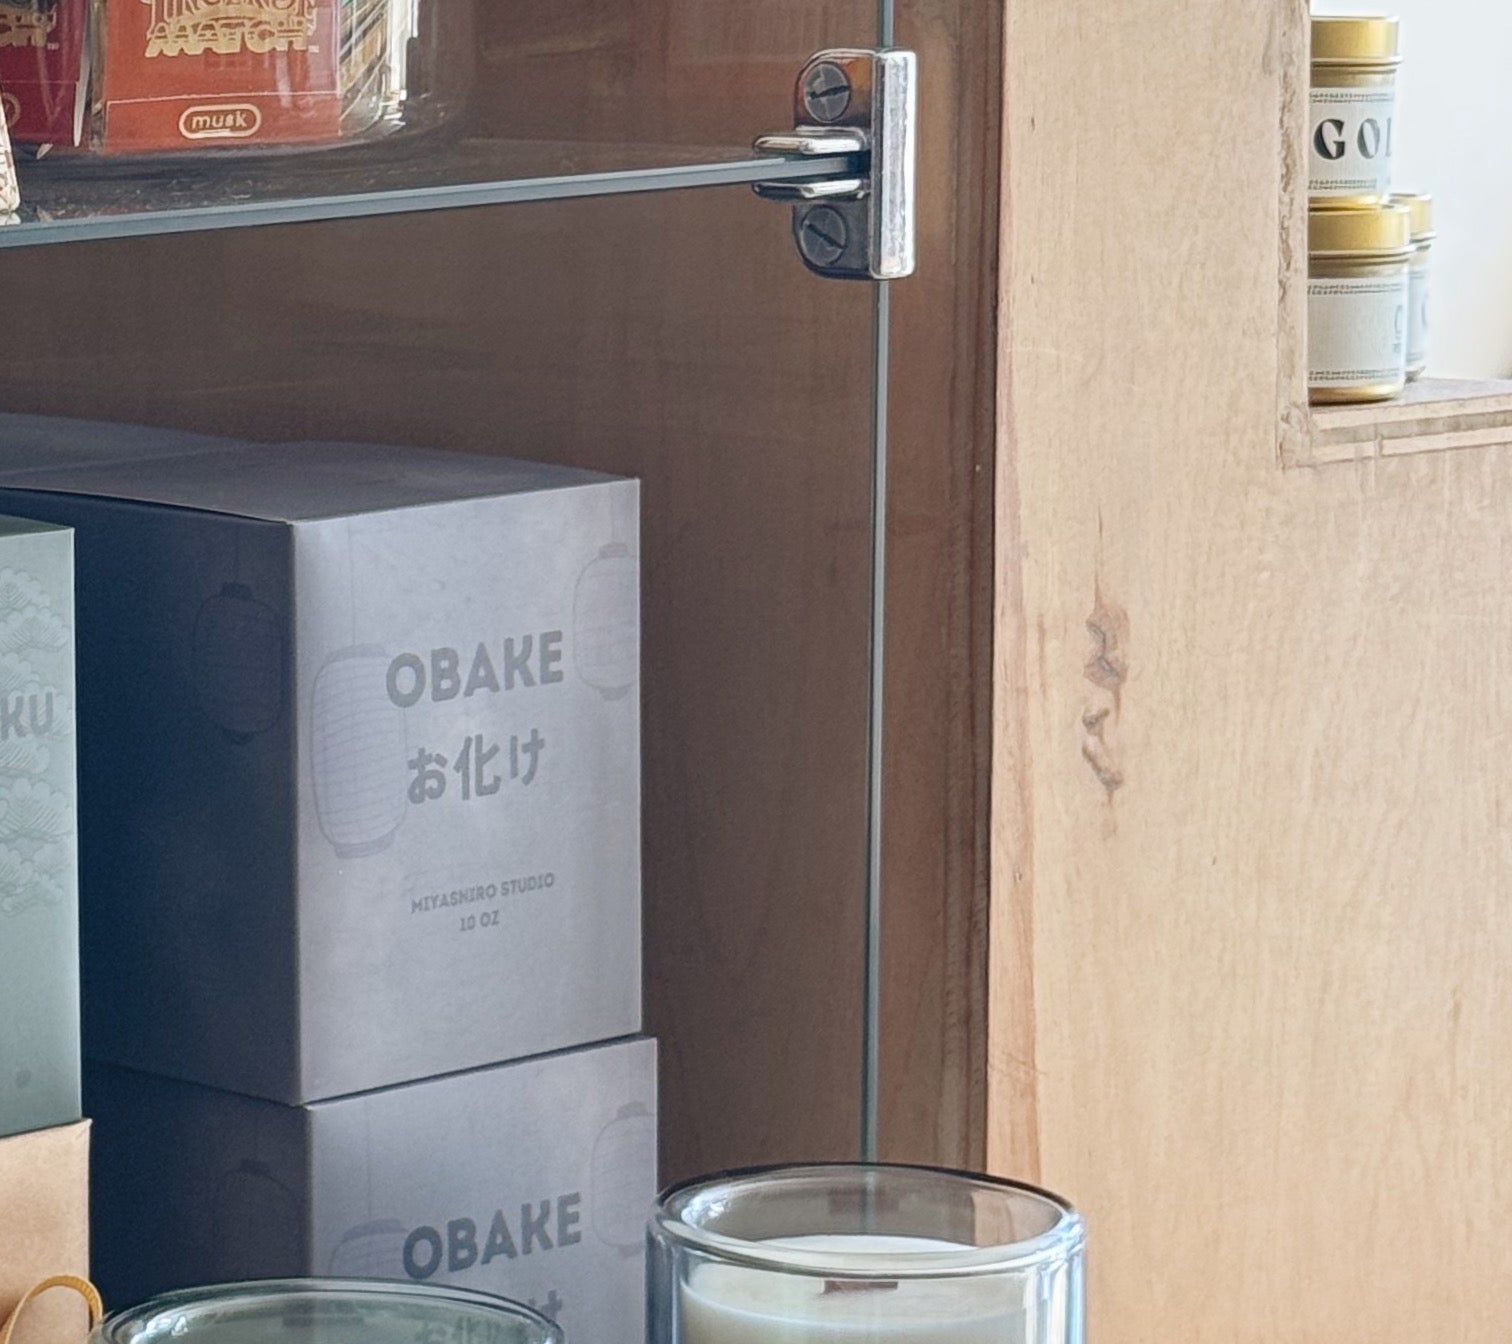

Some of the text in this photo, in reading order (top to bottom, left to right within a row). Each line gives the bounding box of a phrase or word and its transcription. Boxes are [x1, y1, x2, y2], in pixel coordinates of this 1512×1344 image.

[144, 10, 308, 57] MATCH
[191, 110, 248, 130] musk
[386, 630, 564, 708] OBAKE
[406, 727, 546, 805] お化け
[409, 871, 556, 914] MIYASHIRO STUDIO
[459, 910, 500, 932] 10 OZ
[402, 1191, 582, 1280] OBAKE
